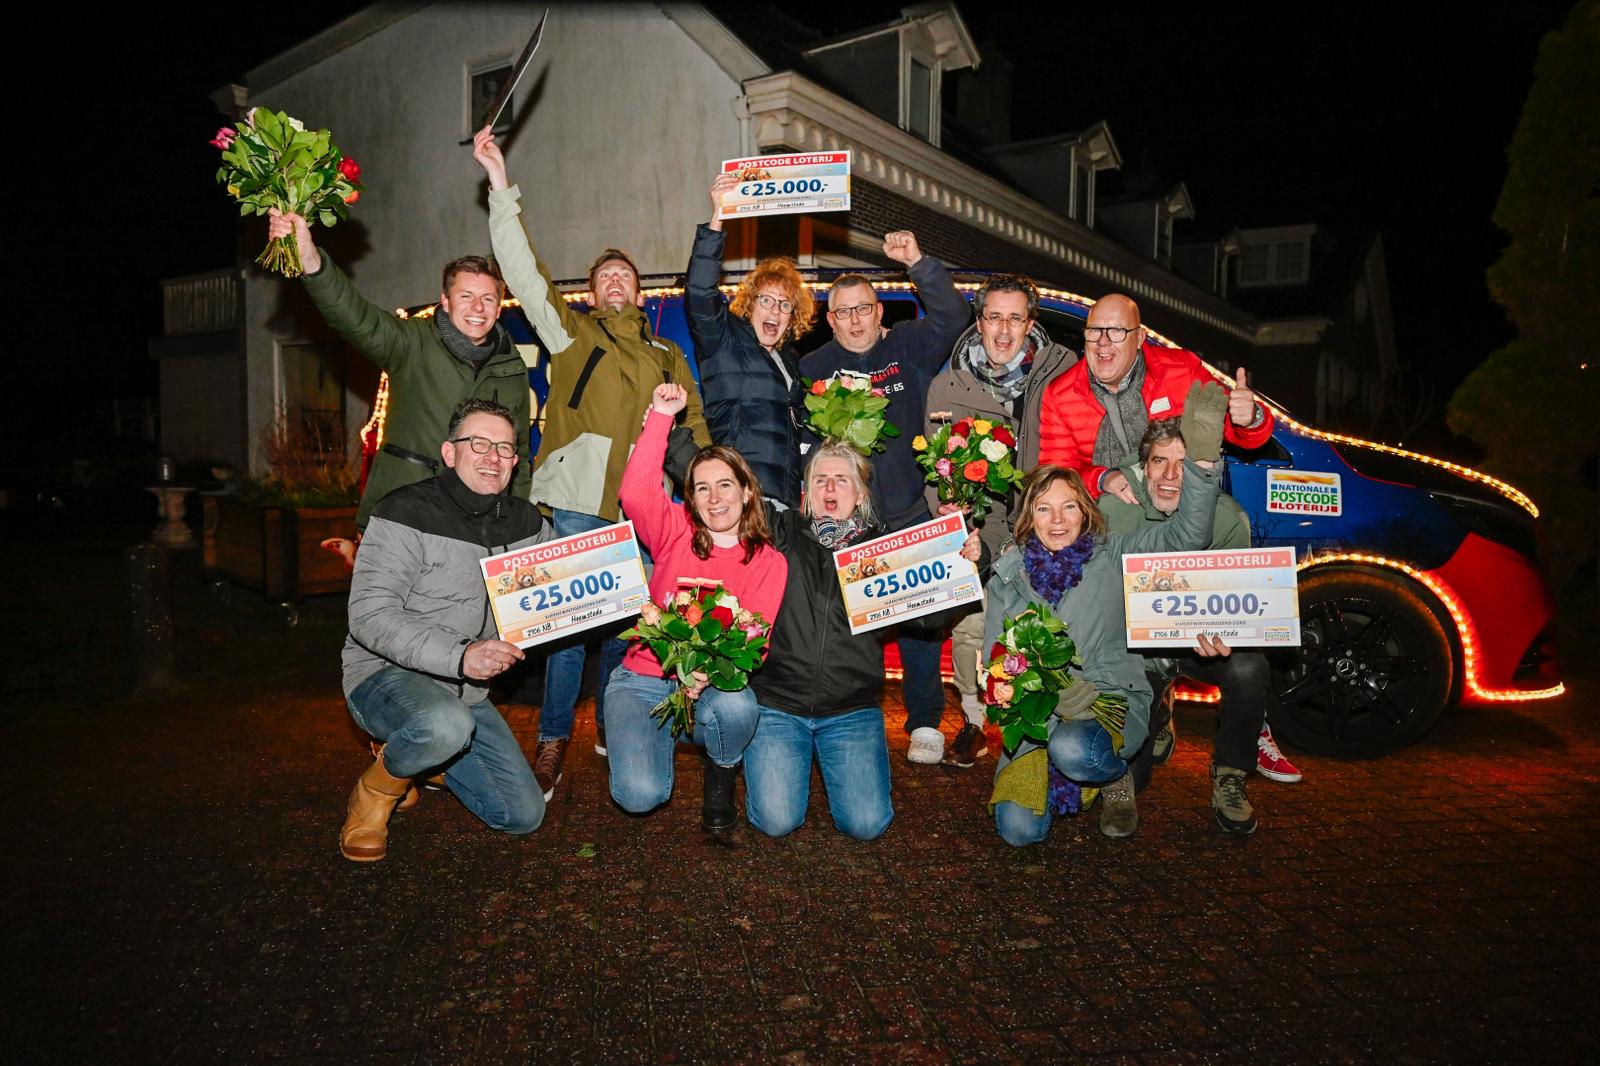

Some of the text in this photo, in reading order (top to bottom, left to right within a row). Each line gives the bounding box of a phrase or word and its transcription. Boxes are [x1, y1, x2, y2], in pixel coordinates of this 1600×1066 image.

[738, 155, 833, 169] POSTCODE LOTERIJ
[1279, 484, 1329, 493] NATIONALE
[1271, 491, 1338, 505] POSTCODE
[1279, 503, 1330, 512] LOTERIJ
[850, 523, 947, 561] POSTCODE LOTERIJ
[503, 531, 617, 570] POSTCODE LOTERIJ
[1144, 554, 1272, 570] POSTCODE LOTERIJ
[571, 609, 603, 624] Heemstede
